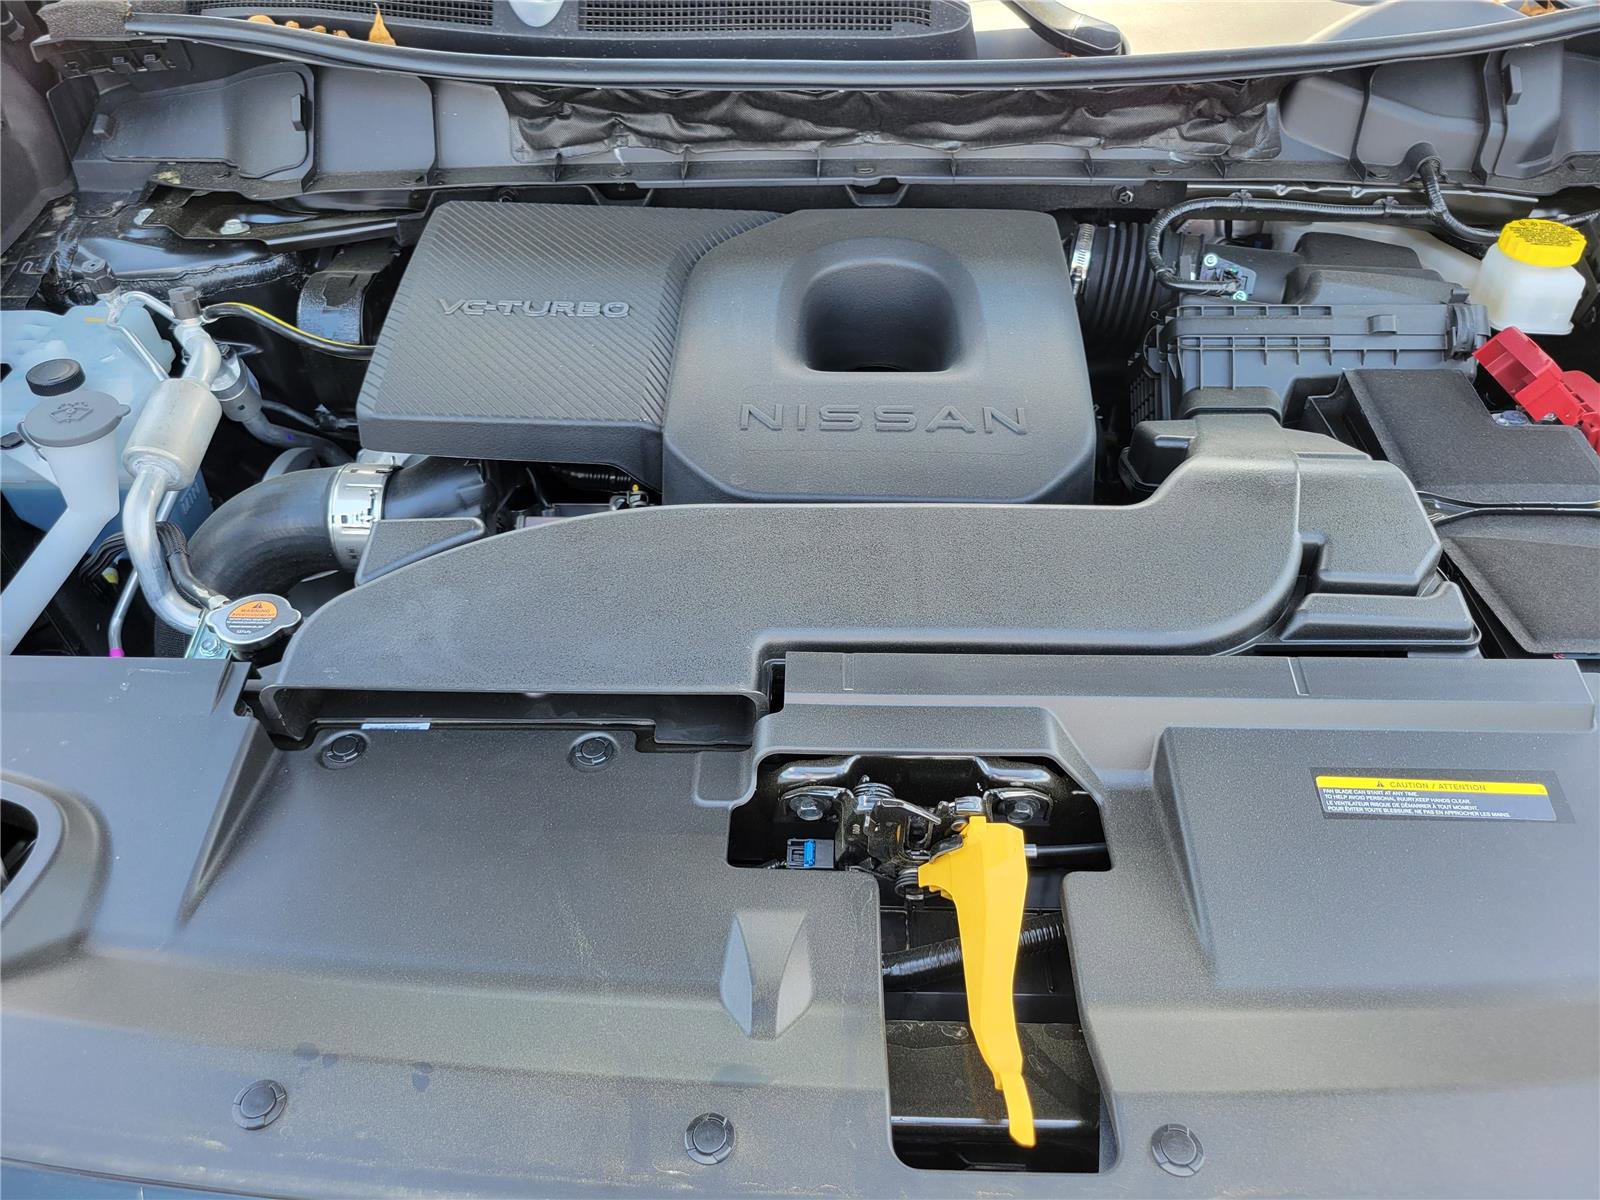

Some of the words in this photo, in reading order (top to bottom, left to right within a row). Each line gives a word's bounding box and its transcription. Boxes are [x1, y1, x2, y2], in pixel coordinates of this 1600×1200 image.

[438, 298, 631, 318] VC-TURBO
[740, 403, 1028, 436] NISSAN
[1389, 781, 1429, 789] CAUTION
[1438, 783, 1486, 791] ATTENTION
